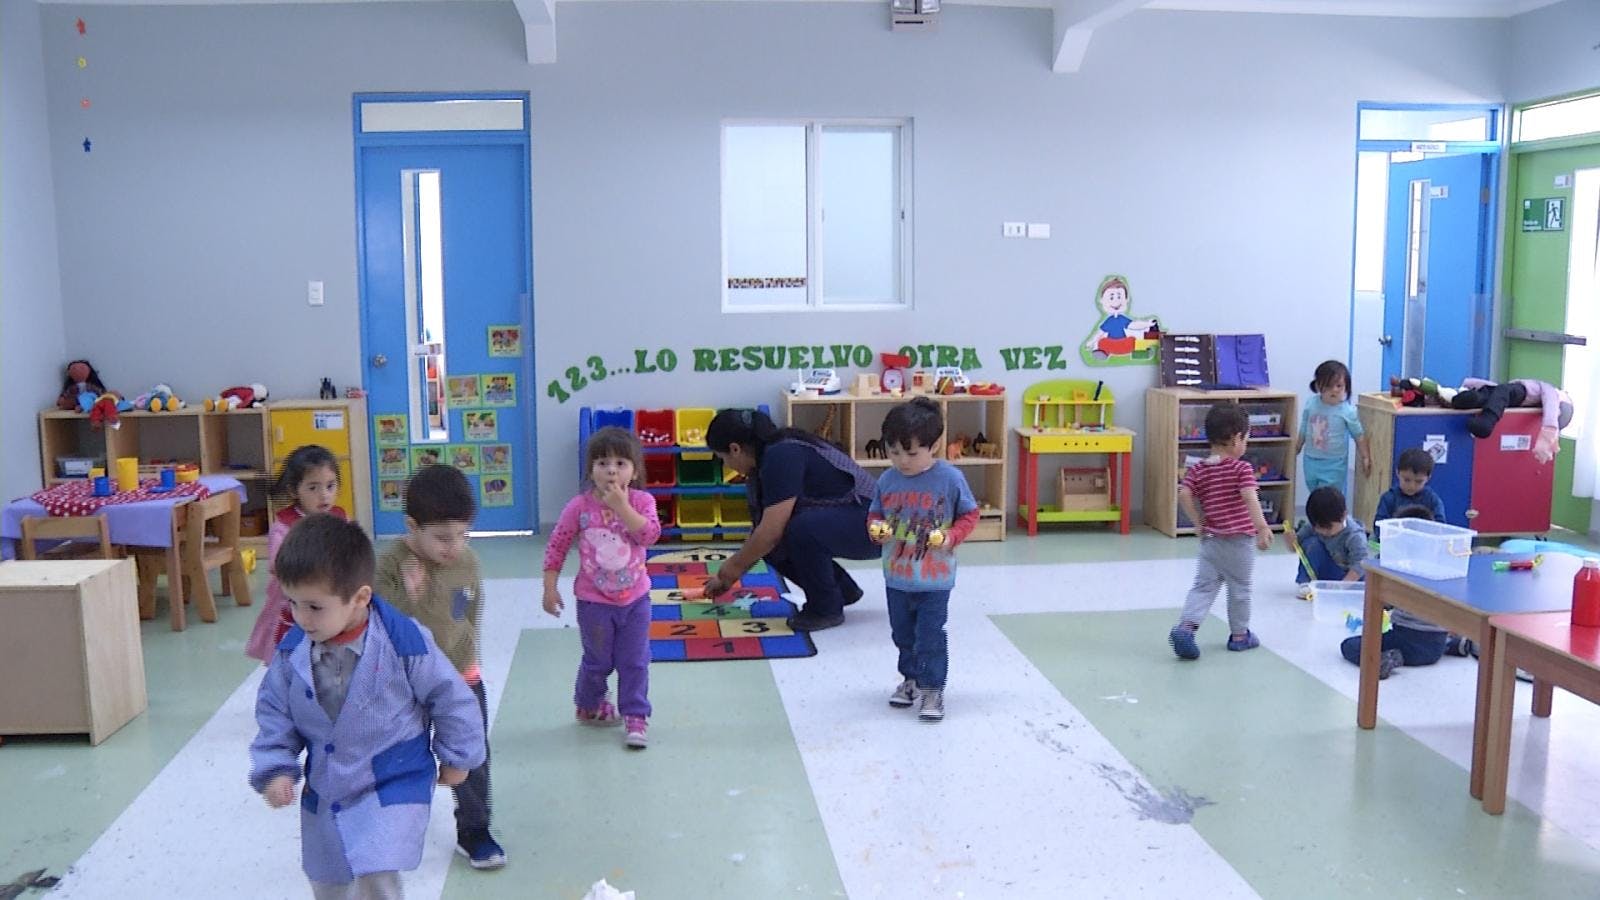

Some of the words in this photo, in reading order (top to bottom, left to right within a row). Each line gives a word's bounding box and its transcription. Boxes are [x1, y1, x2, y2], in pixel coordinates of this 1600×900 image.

[693, 344, 873, 372] RESUELVO
[898, 344, 982, 371] OTRA
[999, 345, 1067, 371] VEZ
[701, 605, 731, 617] 4
[670, 624, 697, 636] 2
[742, 621, 770, 633] 3
[712, 640, 735, 653] 1
